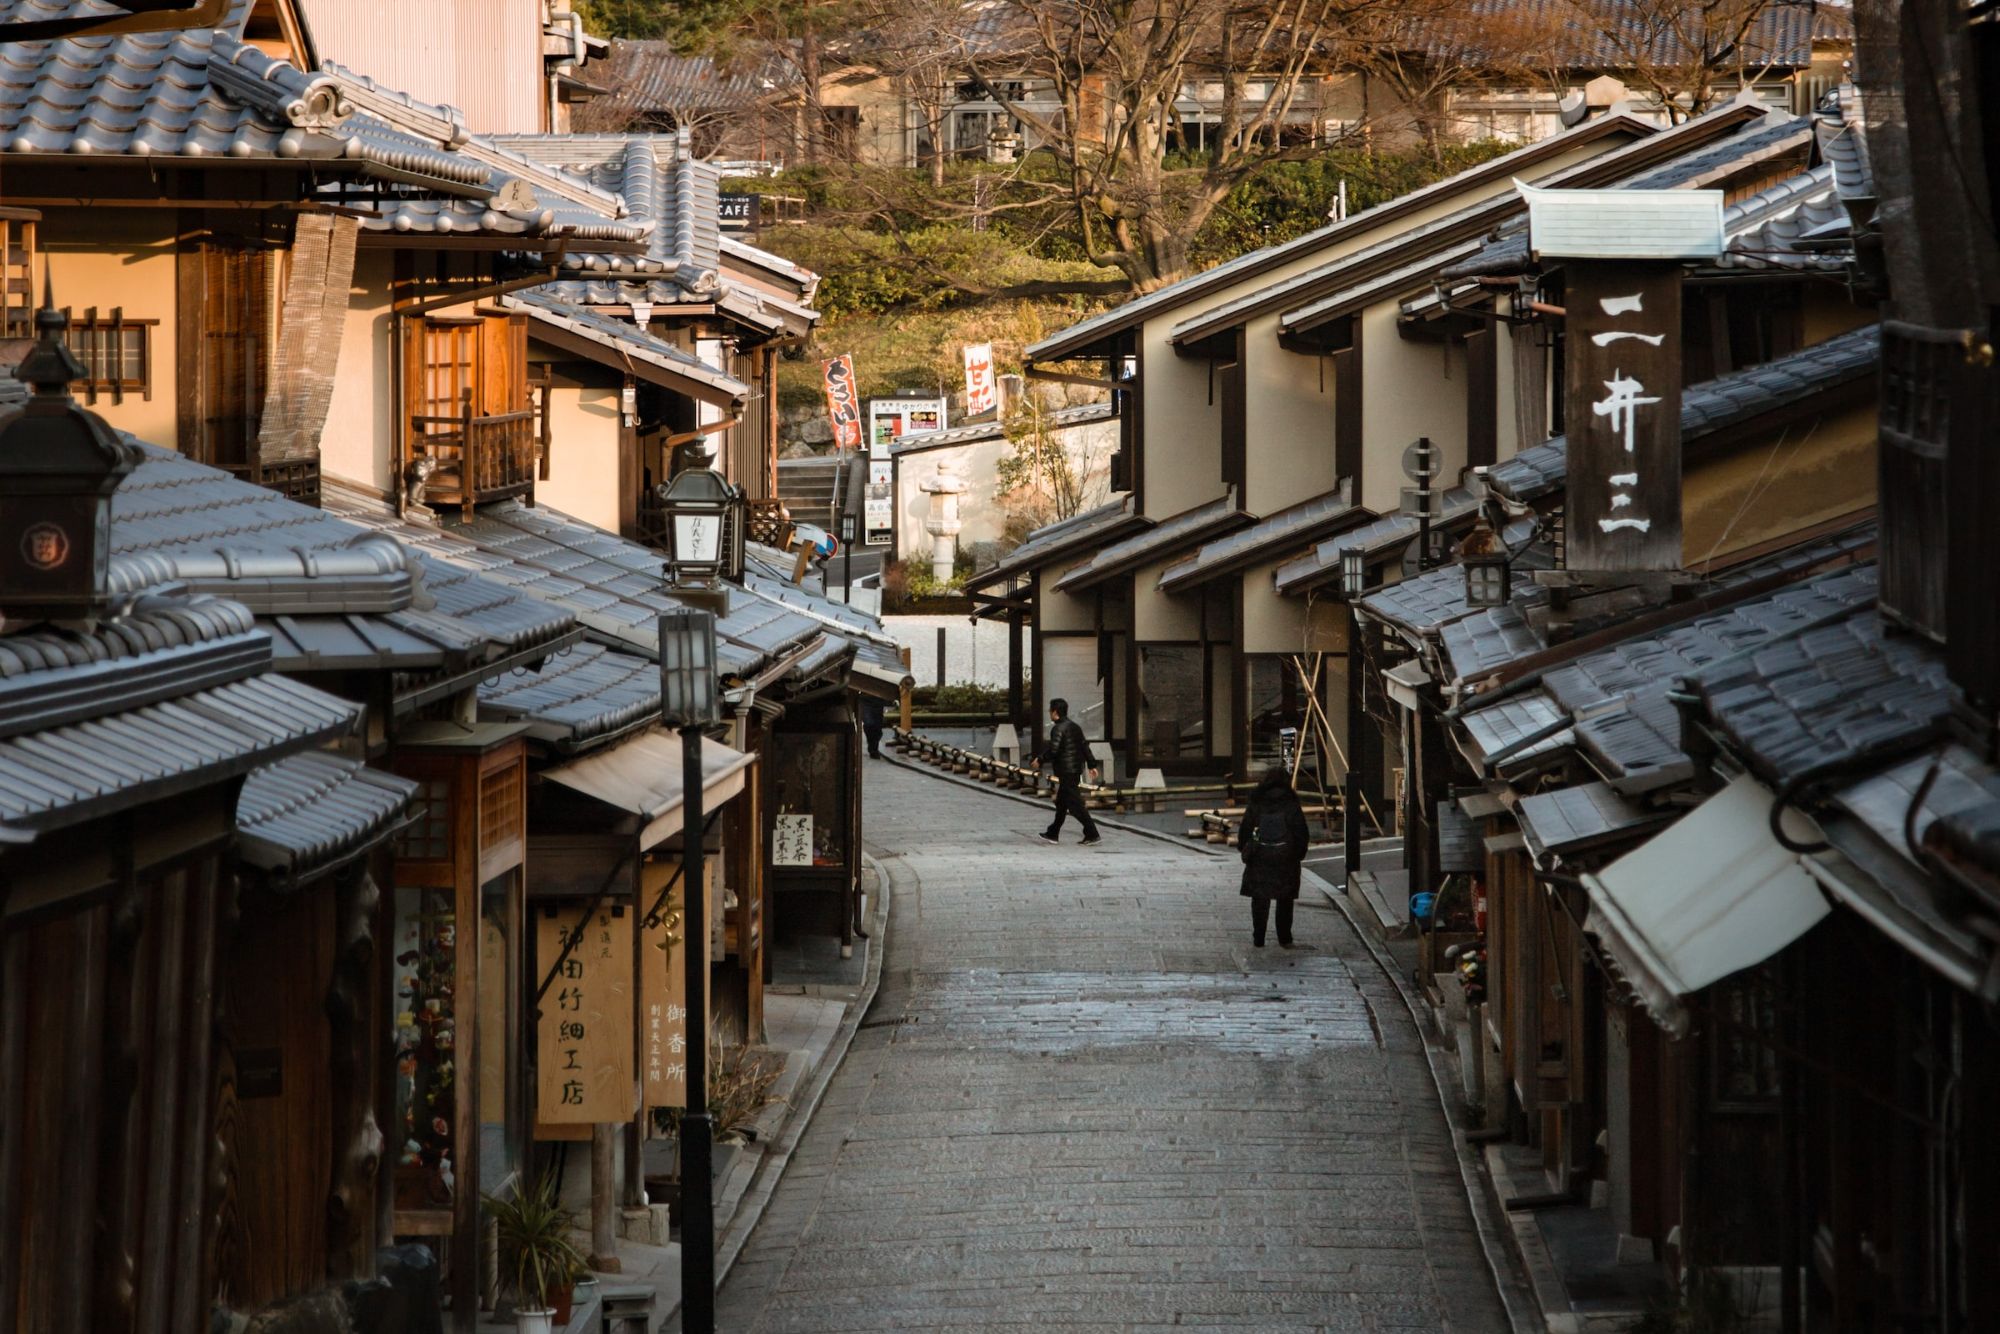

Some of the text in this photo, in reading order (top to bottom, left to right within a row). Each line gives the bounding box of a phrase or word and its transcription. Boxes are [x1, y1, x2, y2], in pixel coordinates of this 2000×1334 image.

[1591, 292, 1665, 533] 二井三
[666, 1003, 687, 1083] 御香所
